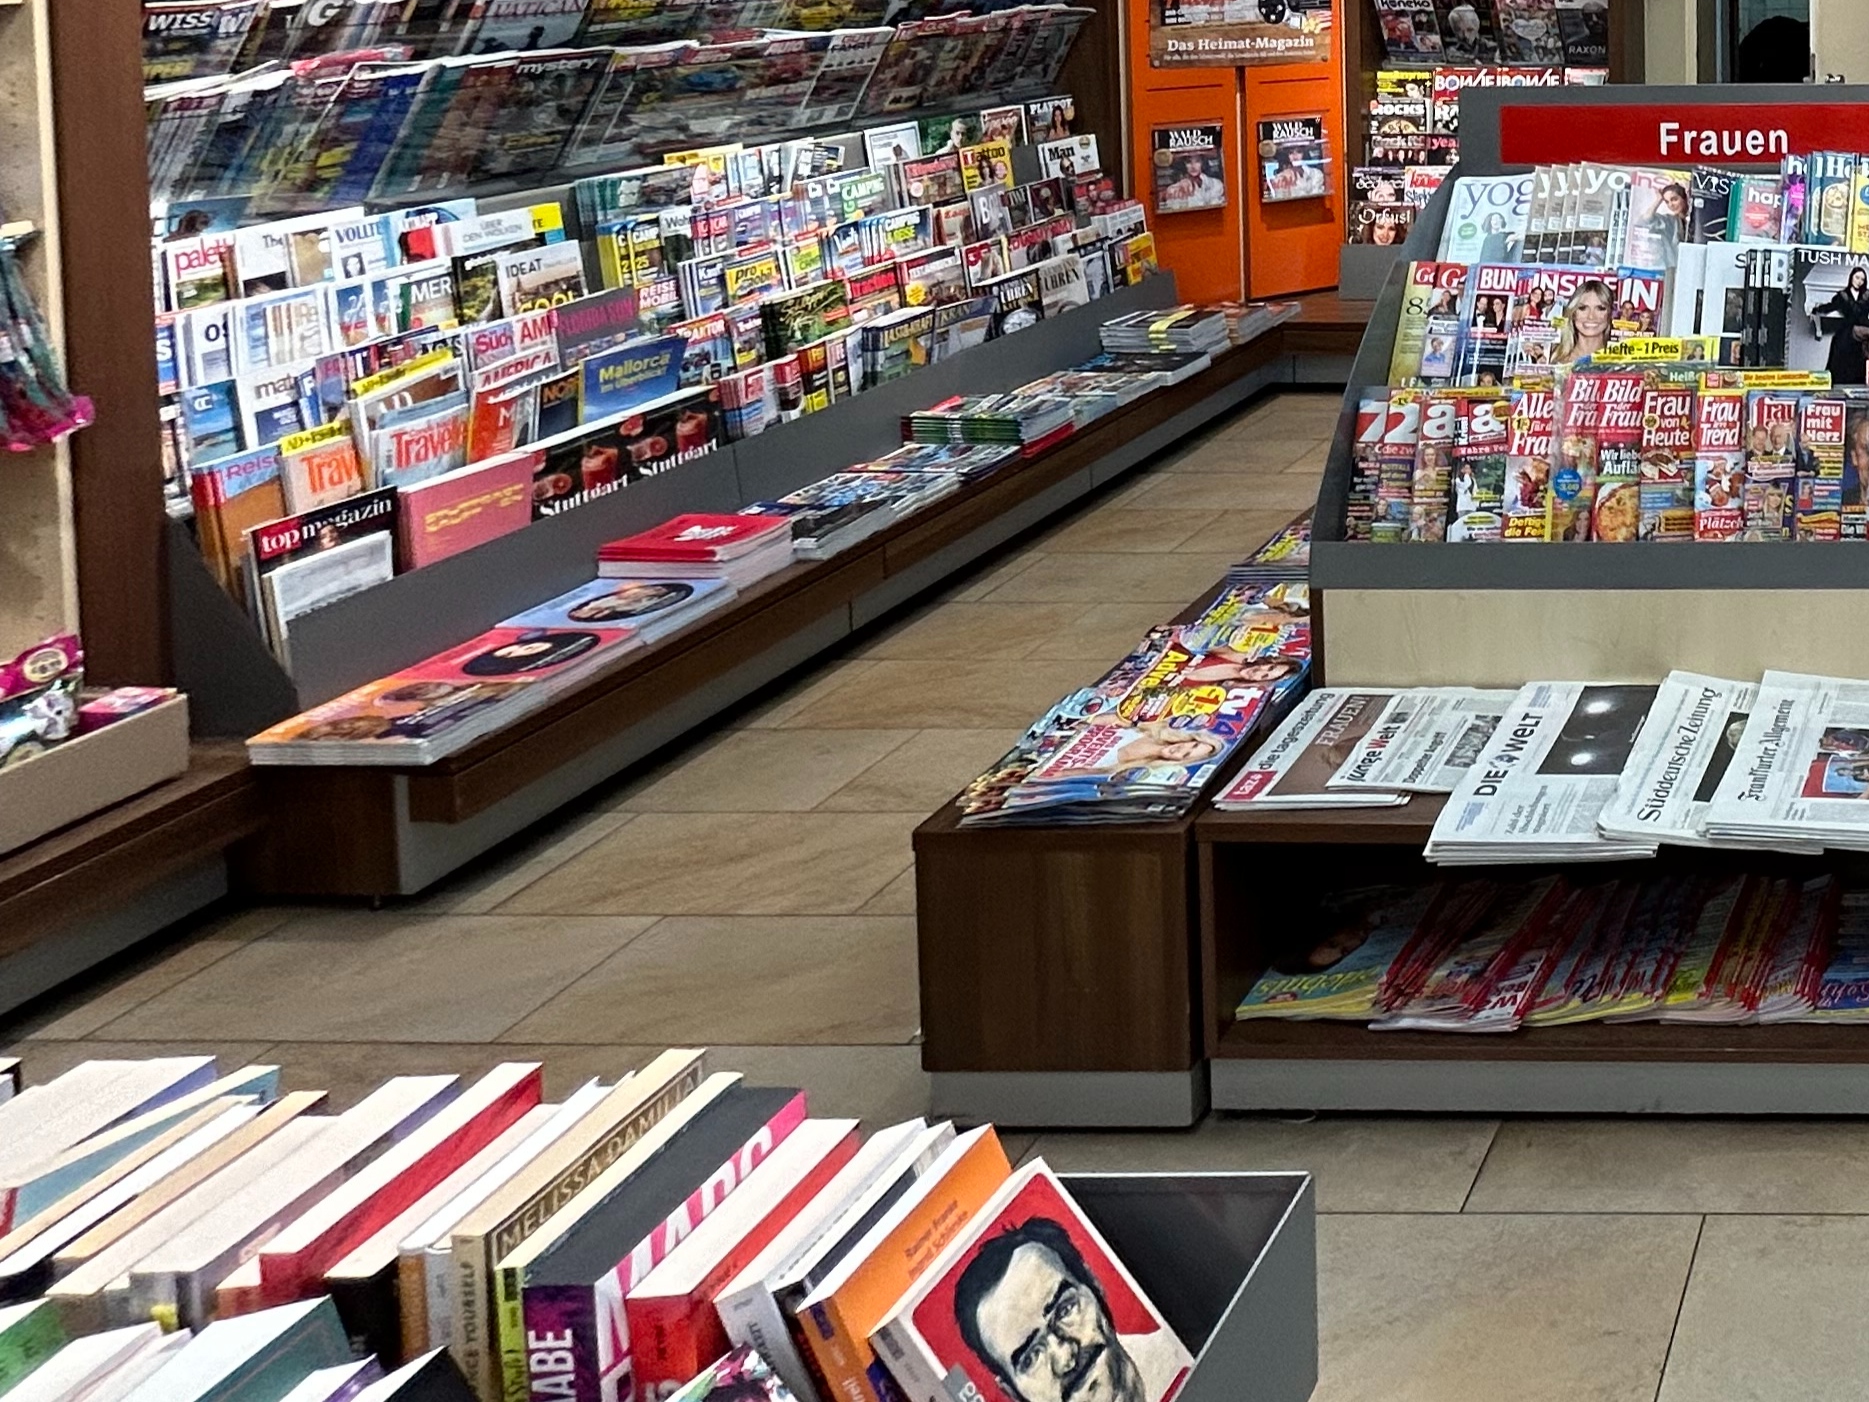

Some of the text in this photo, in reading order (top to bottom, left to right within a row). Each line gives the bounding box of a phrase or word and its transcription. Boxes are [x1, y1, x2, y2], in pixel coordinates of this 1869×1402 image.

[1168, 36, 1314, 52] Das Heimat-Magazin
[1569, 46, 1606, 54] RAXON
[517, 58, 597, 74] mystery
[1372, 103, 1425, 116] ROCKS
[1170, 135, 1213, 147] RAUSCH
[1273, 127, 1314, 139] RAUSCH
[1660, 123, 1789, 155] Frauen
[964, 145, 1005, 166] Tattoo
[1048, 145, 1075, 160] Man
[1461, 180, 1534, 220] yog
[1799, 251, 1842, 266] TUSH
[506, 258, 542, 278] IDEAT
[735, 265, 758, 282] pro
[639, 280, 676, 298] REISE
[640, 292, 679, 310] MOBIL
[1652, 342, 1679, 354] Preis
[600, 349, 671, 381] Mallorca
[1603, 380, 1642, 402] Bild
[1644, 395, 1690, 416] Frau
[1701, 399, 1740, 422] Frau
[1807, 404, 1840, 416] Frau
[1602, 404, 1642, 427] Frau
[1661, 418, 1680, 428] von
[1807, 417, 1827, 428] mit
[1643, 431, 1689, 447] Heute
[1701, 424, 1739, 446] Trend
[1602, 451, 1618, 461] Wir
[261, 529, 300, 553] top
[1505, 528, 1523, 537] die
[1233, 692, 1336, 801] taz die tageszeitung
[1346, 721, 1401, 782] junge Welt
[1472, 767, 1507, 797] DIE
[1502, 712, 1544, 754] WELT
[1637, 686, 1721, 823] Süddeutsche Zeitung
